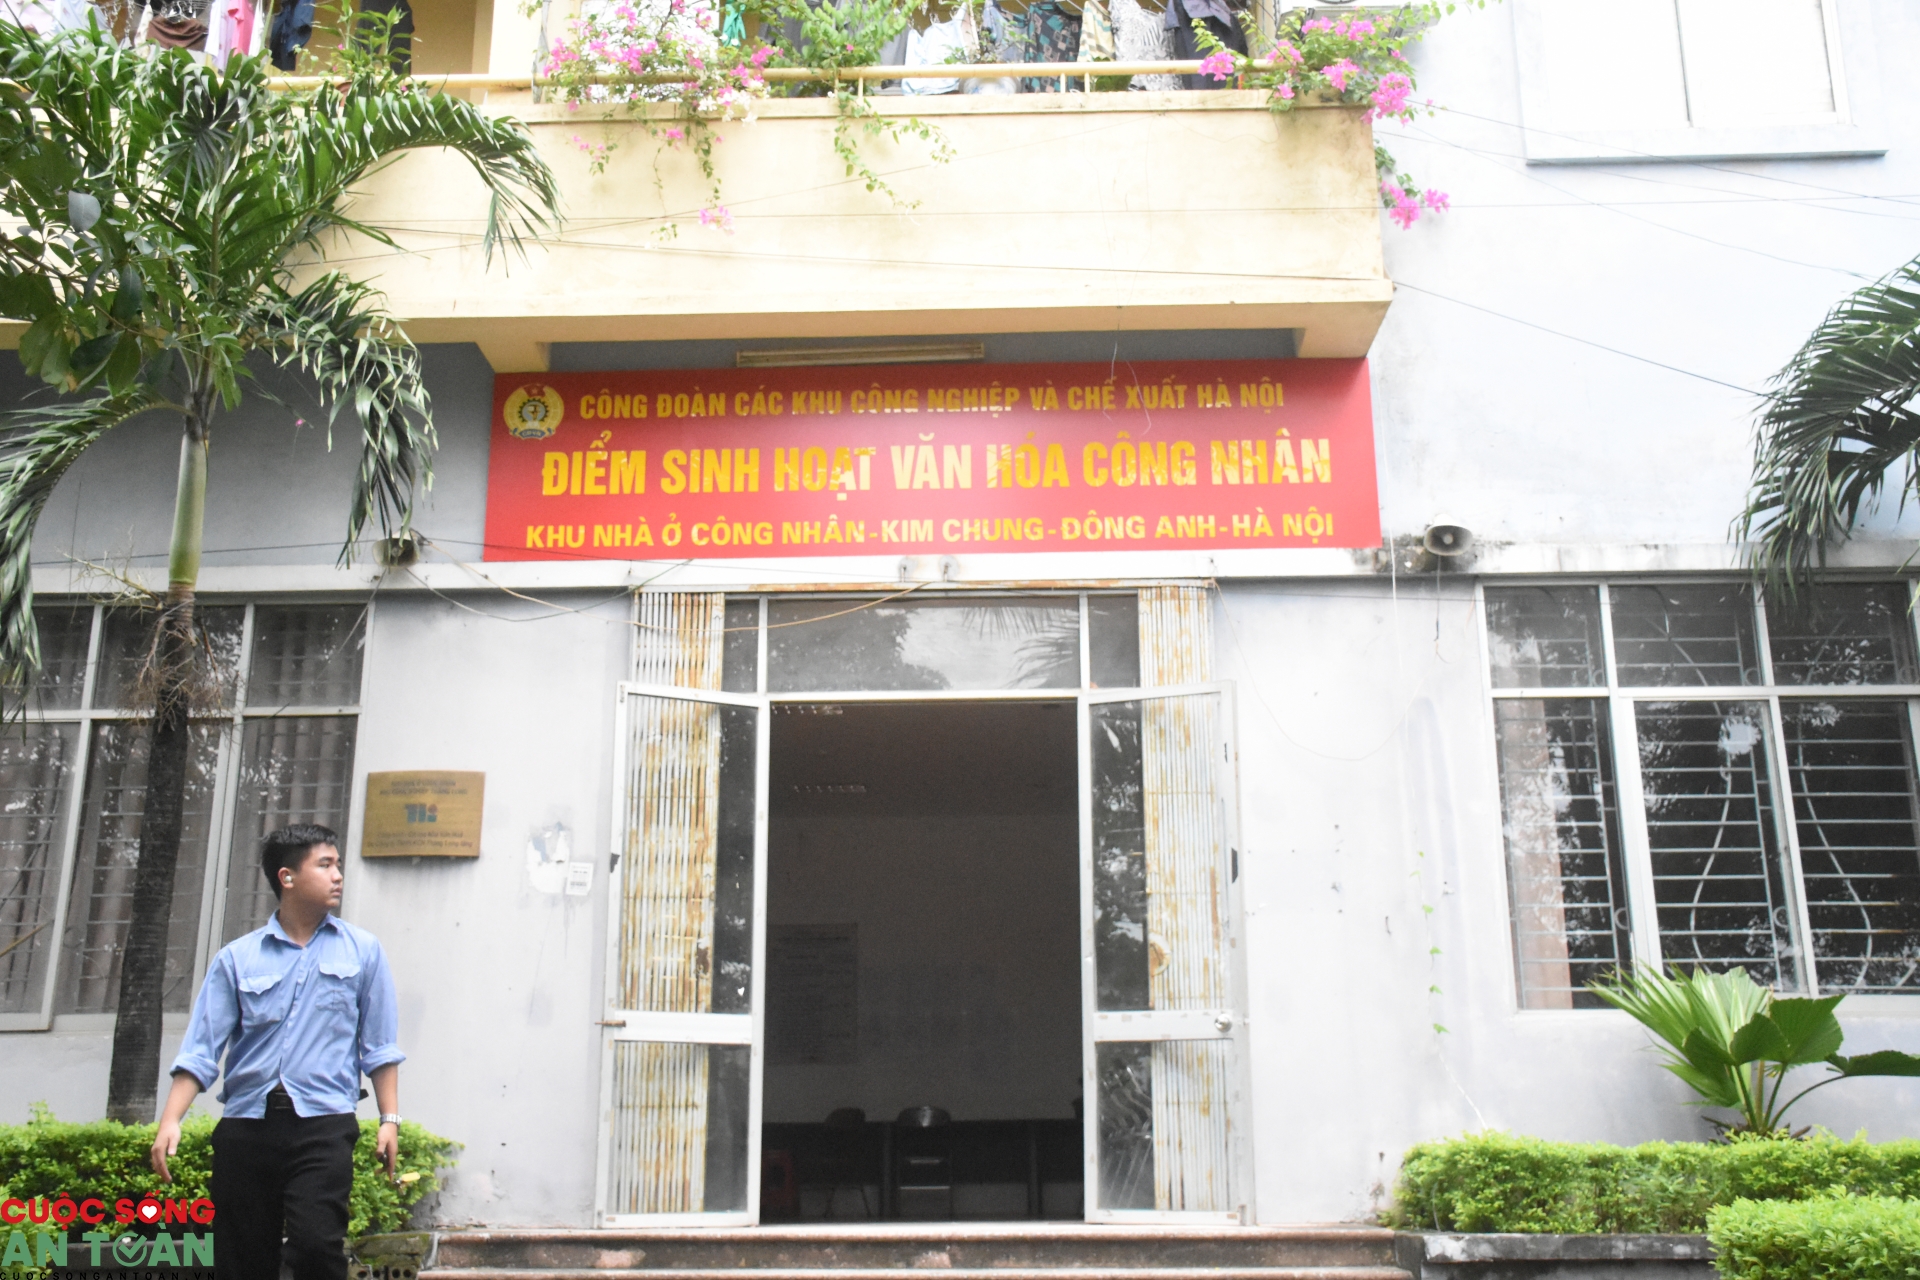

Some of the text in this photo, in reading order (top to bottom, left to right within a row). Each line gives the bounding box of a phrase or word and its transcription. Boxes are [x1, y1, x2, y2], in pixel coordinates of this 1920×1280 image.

[580, 374, 1284, 419] CÔNG ĐOÀN CÁC KHU CÔNG NGHIỆP VÀ CHẾ XUẤT HÀ NỘI
[541, 427, 1332, 501] ĐIỂM SINH HOẠT VĂN HÓA CÔNG NHÂN
[526, 524, 585, 549] KHU
[593, 517, 654, 548] NHÀ
[662, 512, 682, 547] Ở
[691, 515, 774, 546] CÔNG
[1283, 507, 1334, 544] NỘI
